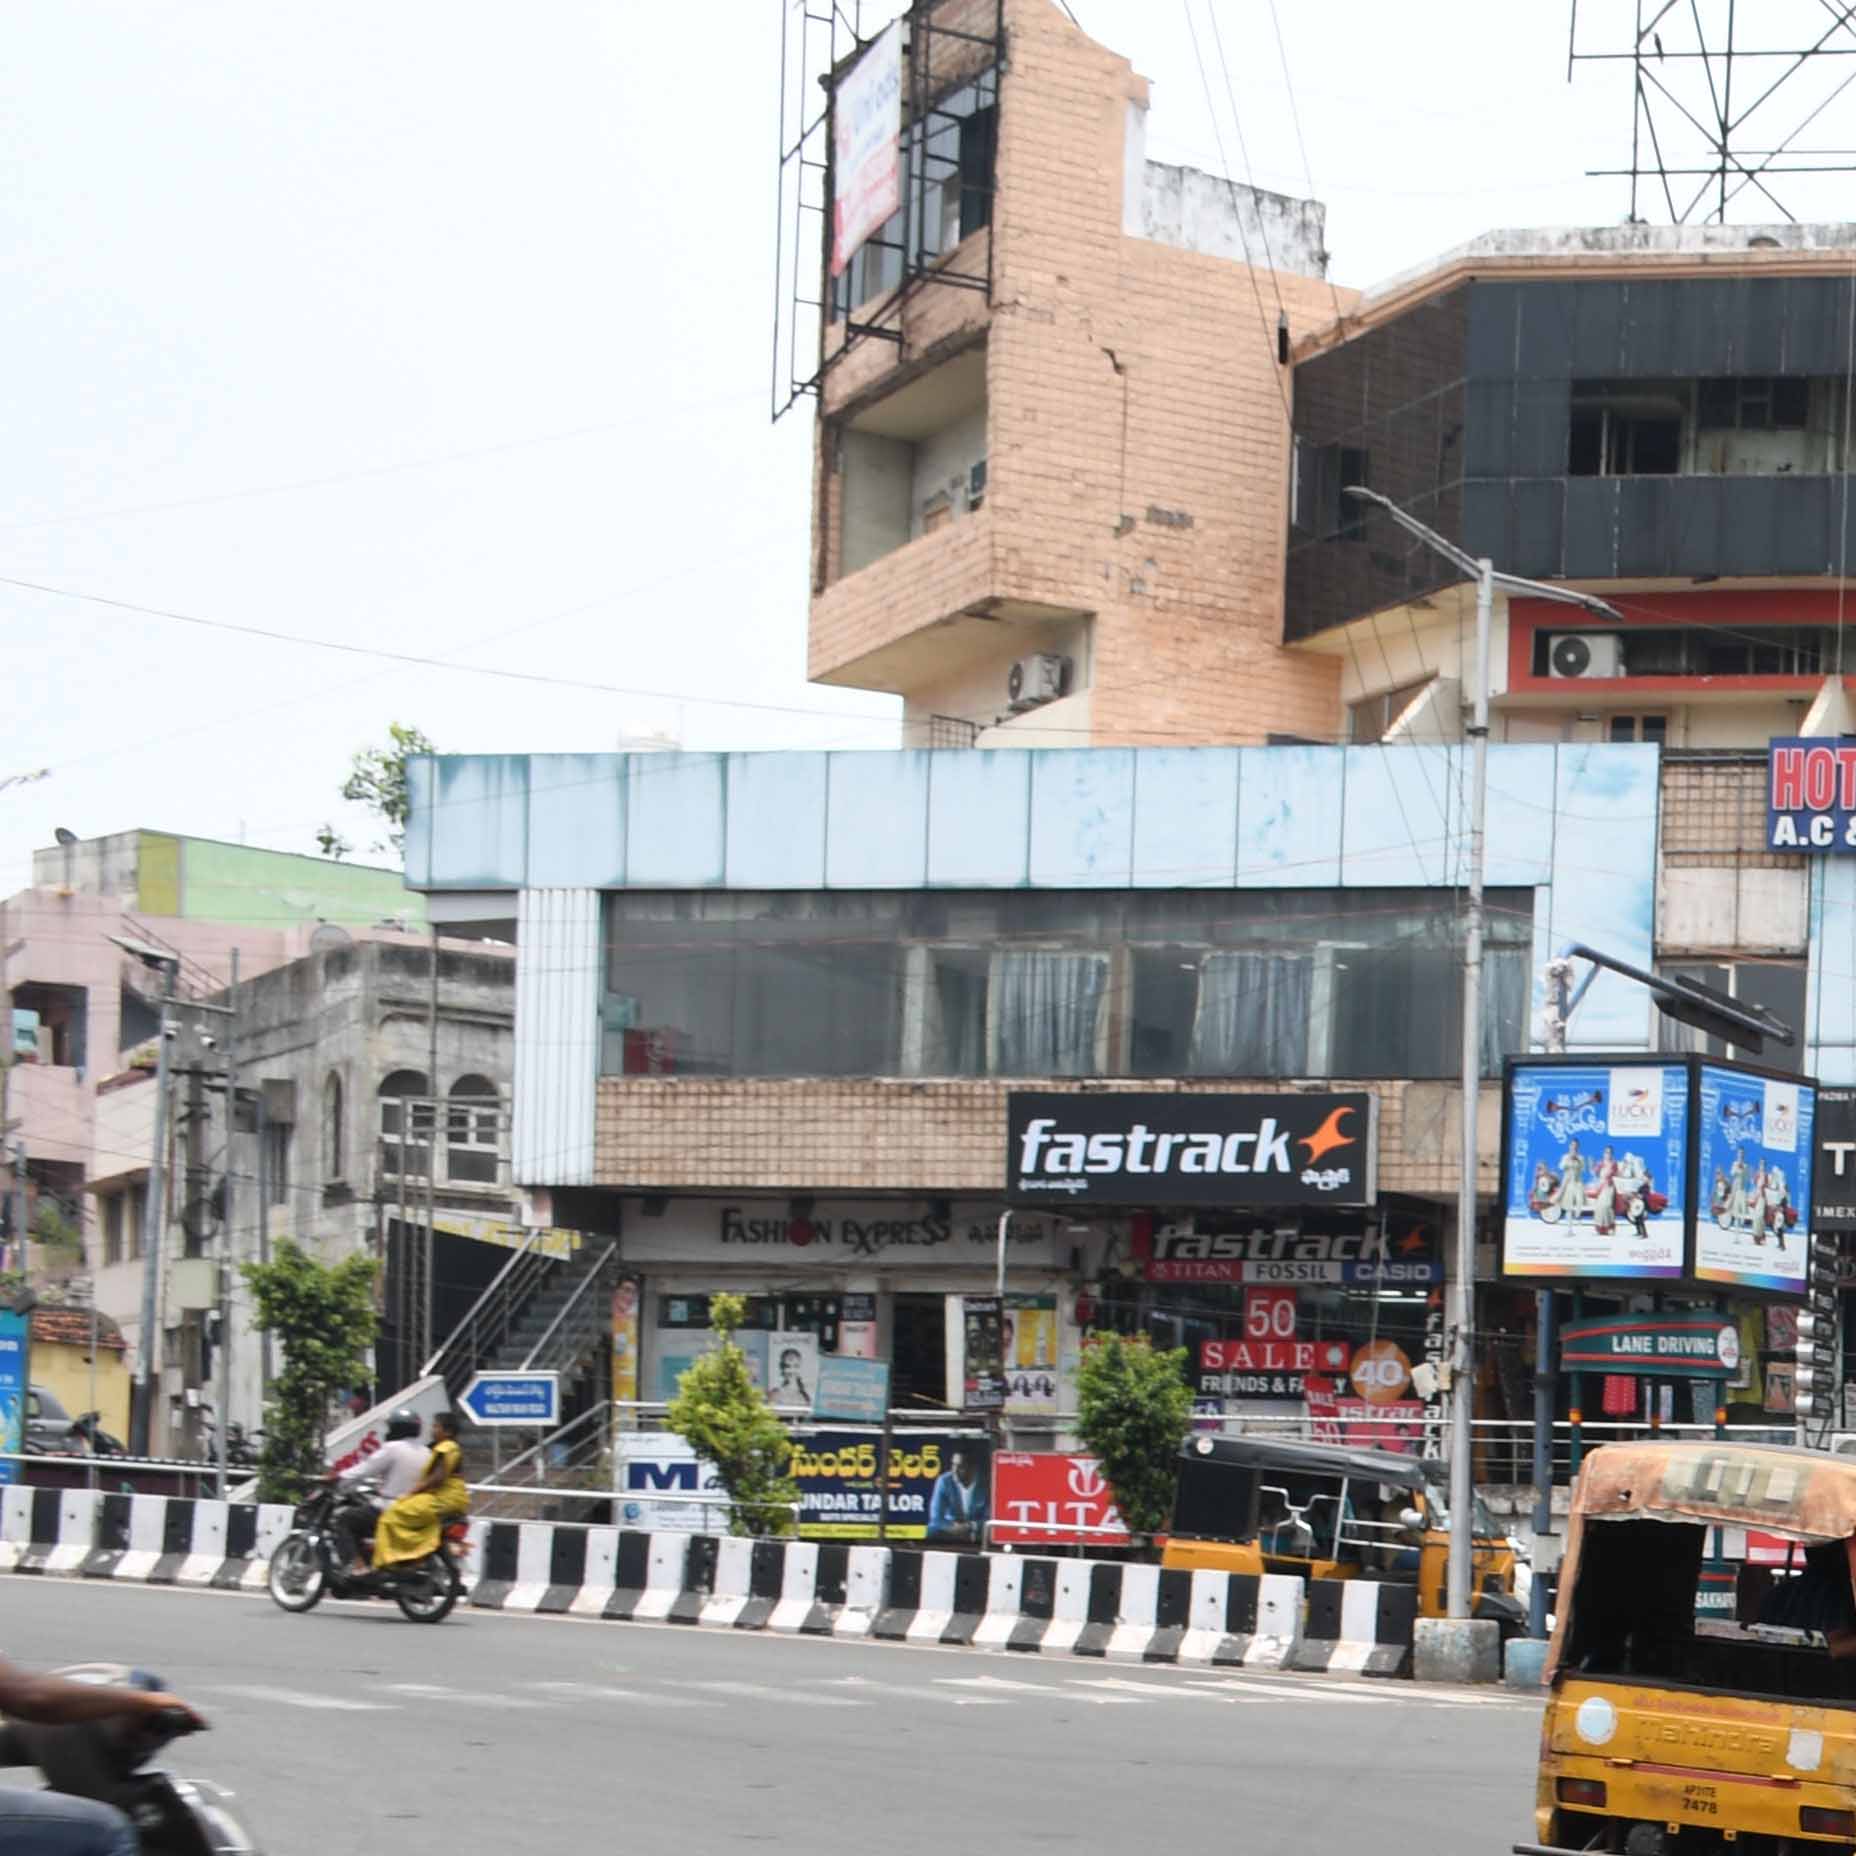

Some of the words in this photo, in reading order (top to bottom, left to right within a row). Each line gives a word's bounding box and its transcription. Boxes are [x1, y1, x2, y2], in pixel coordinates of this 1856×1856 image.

[1773, 815, 1835, 847] A.C
[1019, 1118, 1292, 1174] fastrack
[1815, 1206, 1856, 1219] IMEX
[1154, 1224, 1392, 1261] fastrack
[1172, 1263, 1232, 1279] TITAN
[1255, 1263, 1329, 1280] FOSSIL
[1354, 1264, 1431, 1281] CASIO
[1247, 1299, 1297, 1337] 50
[1612, 1334, 1653, 1353] LANE
[1657, 1334, 1716, 1355] DRIVING
[1204, 1343, 1315, 1369] SALE
[799, 1493, 859, 1511] UNDAR
[861, 1494, 924, 1512] TALOR
[1007, 1500, 1129, 1535] TITA
[1682, 1797, 1718, 1815] 7478
